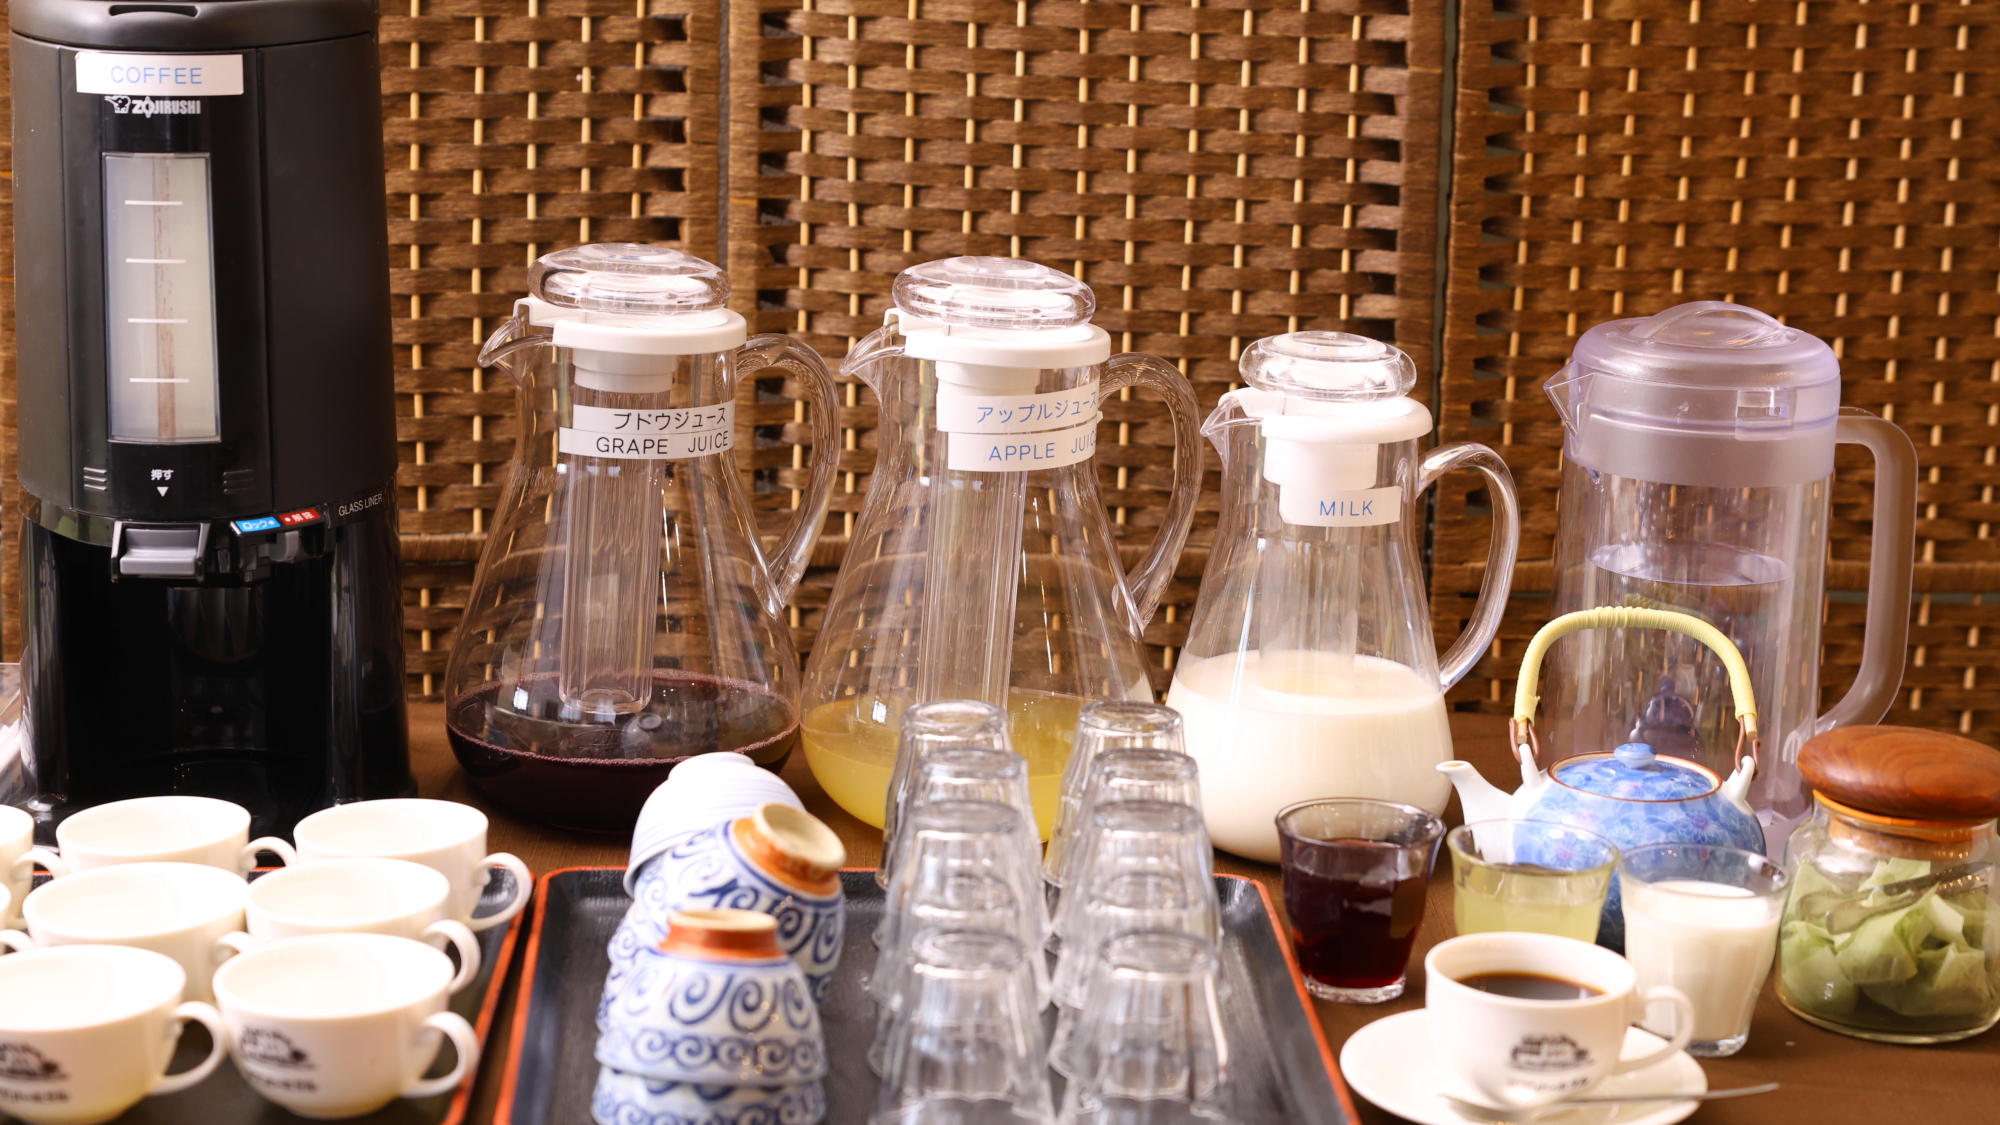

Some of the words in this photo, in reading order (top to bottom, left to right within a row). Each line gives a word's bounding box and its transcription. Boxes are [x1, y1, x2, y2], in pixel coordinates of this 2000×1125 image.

[111, 66, 203, 84] COFFEE
[131, 96, 201, 118] ZOJIRUSHI
[977, 391, 1097, 424] アップルジュース
[614, 407, 726, 431] ブドウジュース
[596, 436, 669, 455] GRAPE
[687, 430, 729, 453] JUICE
[989, 442, 1055, 461] APPLE
[151, 468, 174, 481] 押す
[338, 500, 364, 517] GLASS
[364, 493, 382, 509] LINER
[1319, 500, 1373, 517] MILK
[242, 519, 268, 531] ロック
